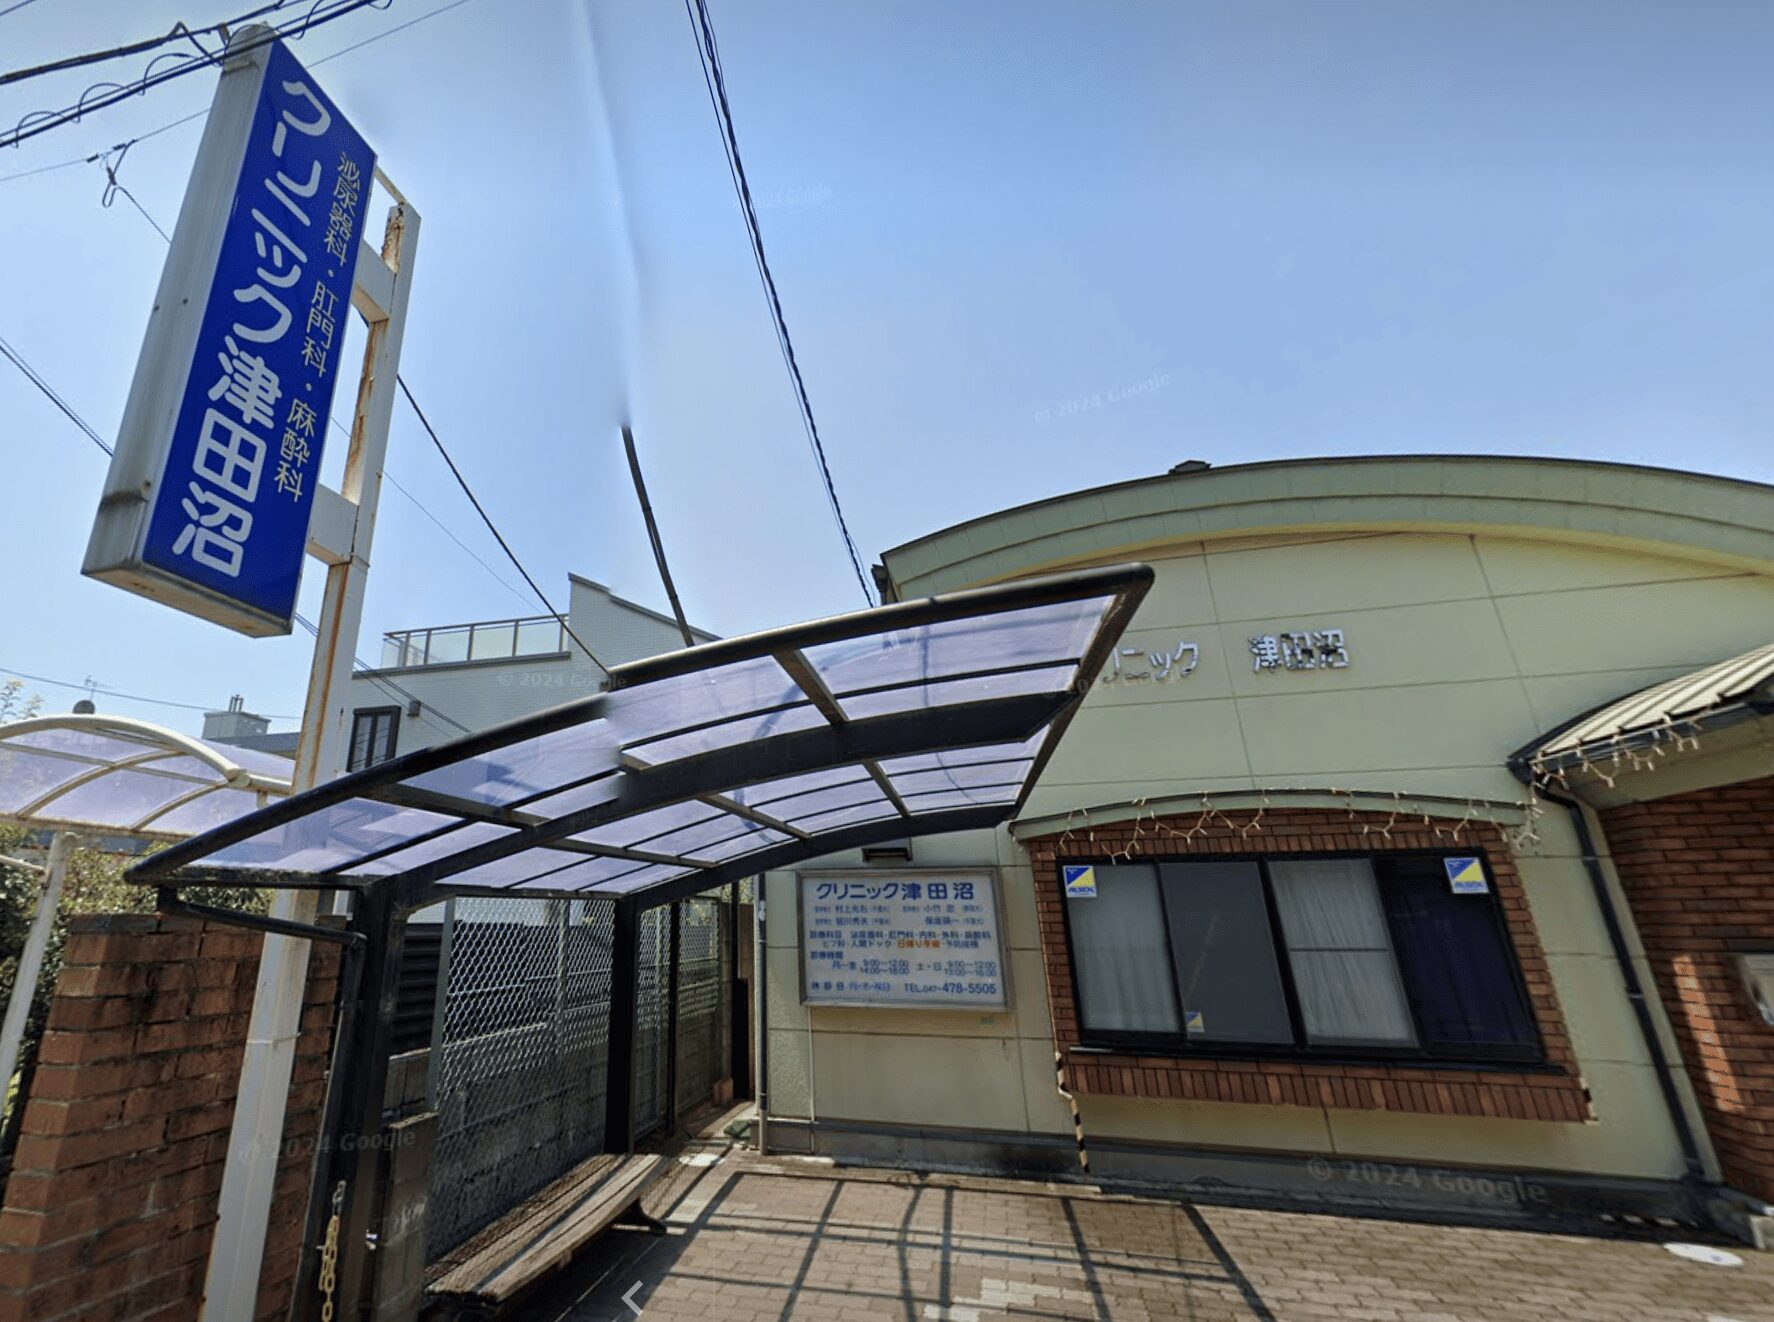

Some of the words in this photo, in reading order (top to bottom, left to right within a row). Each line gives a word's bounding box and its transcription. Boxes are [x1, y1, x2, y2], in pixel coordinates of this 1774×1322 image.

[172, 80, 332, 577] クリニック津田沼
[274, 152, 361, 503] 泌尿器科・肛門科・麻酔科
[816, 882, 974, 901] クリニック津田沼
